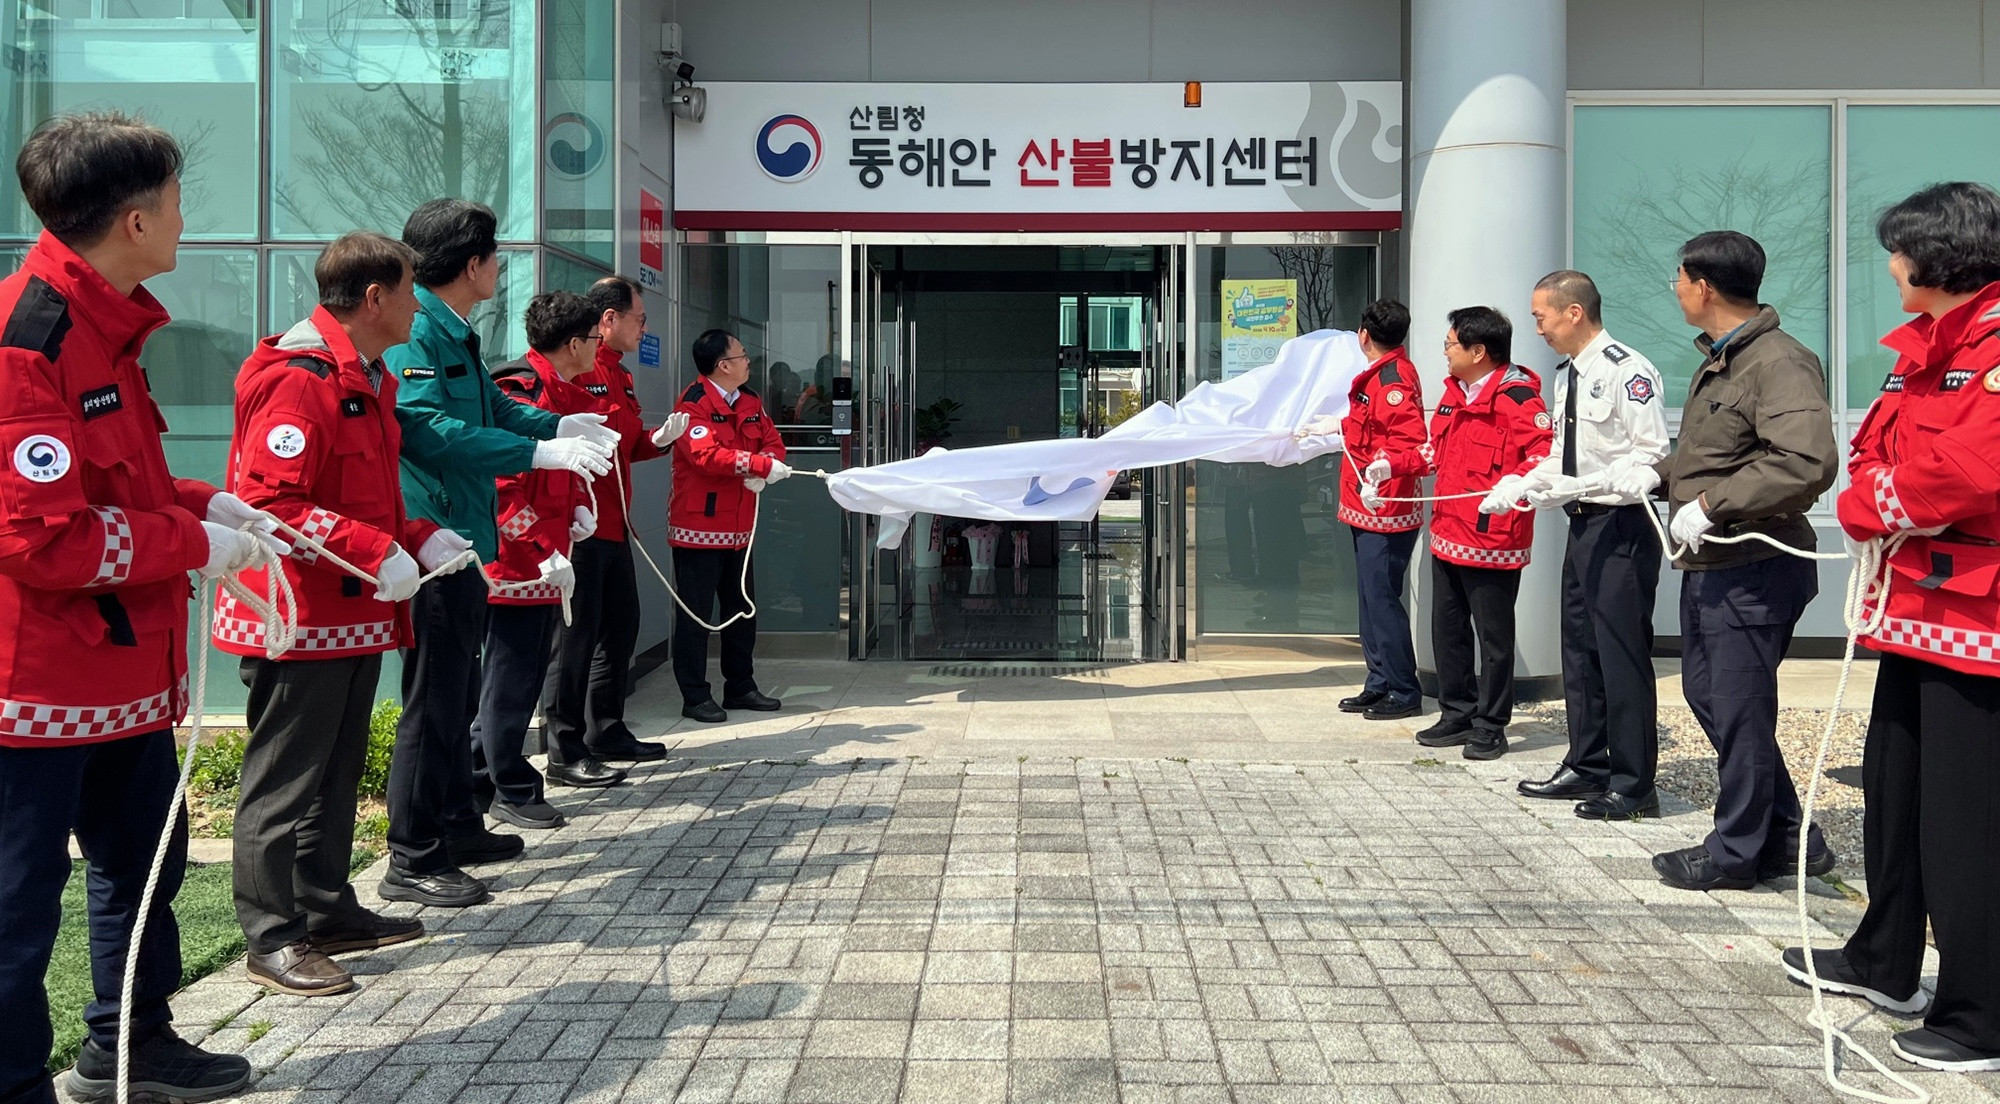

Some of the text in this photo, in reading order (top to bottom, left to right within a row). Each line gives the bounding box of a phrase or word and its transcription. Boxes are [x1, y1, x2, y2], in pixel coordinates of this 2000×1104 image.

[849, 105, 925, 132] 산림청
[849, 136, 1317, 189] 동해안 산불방지센터
[32, 468, 60, 478] 산림청
